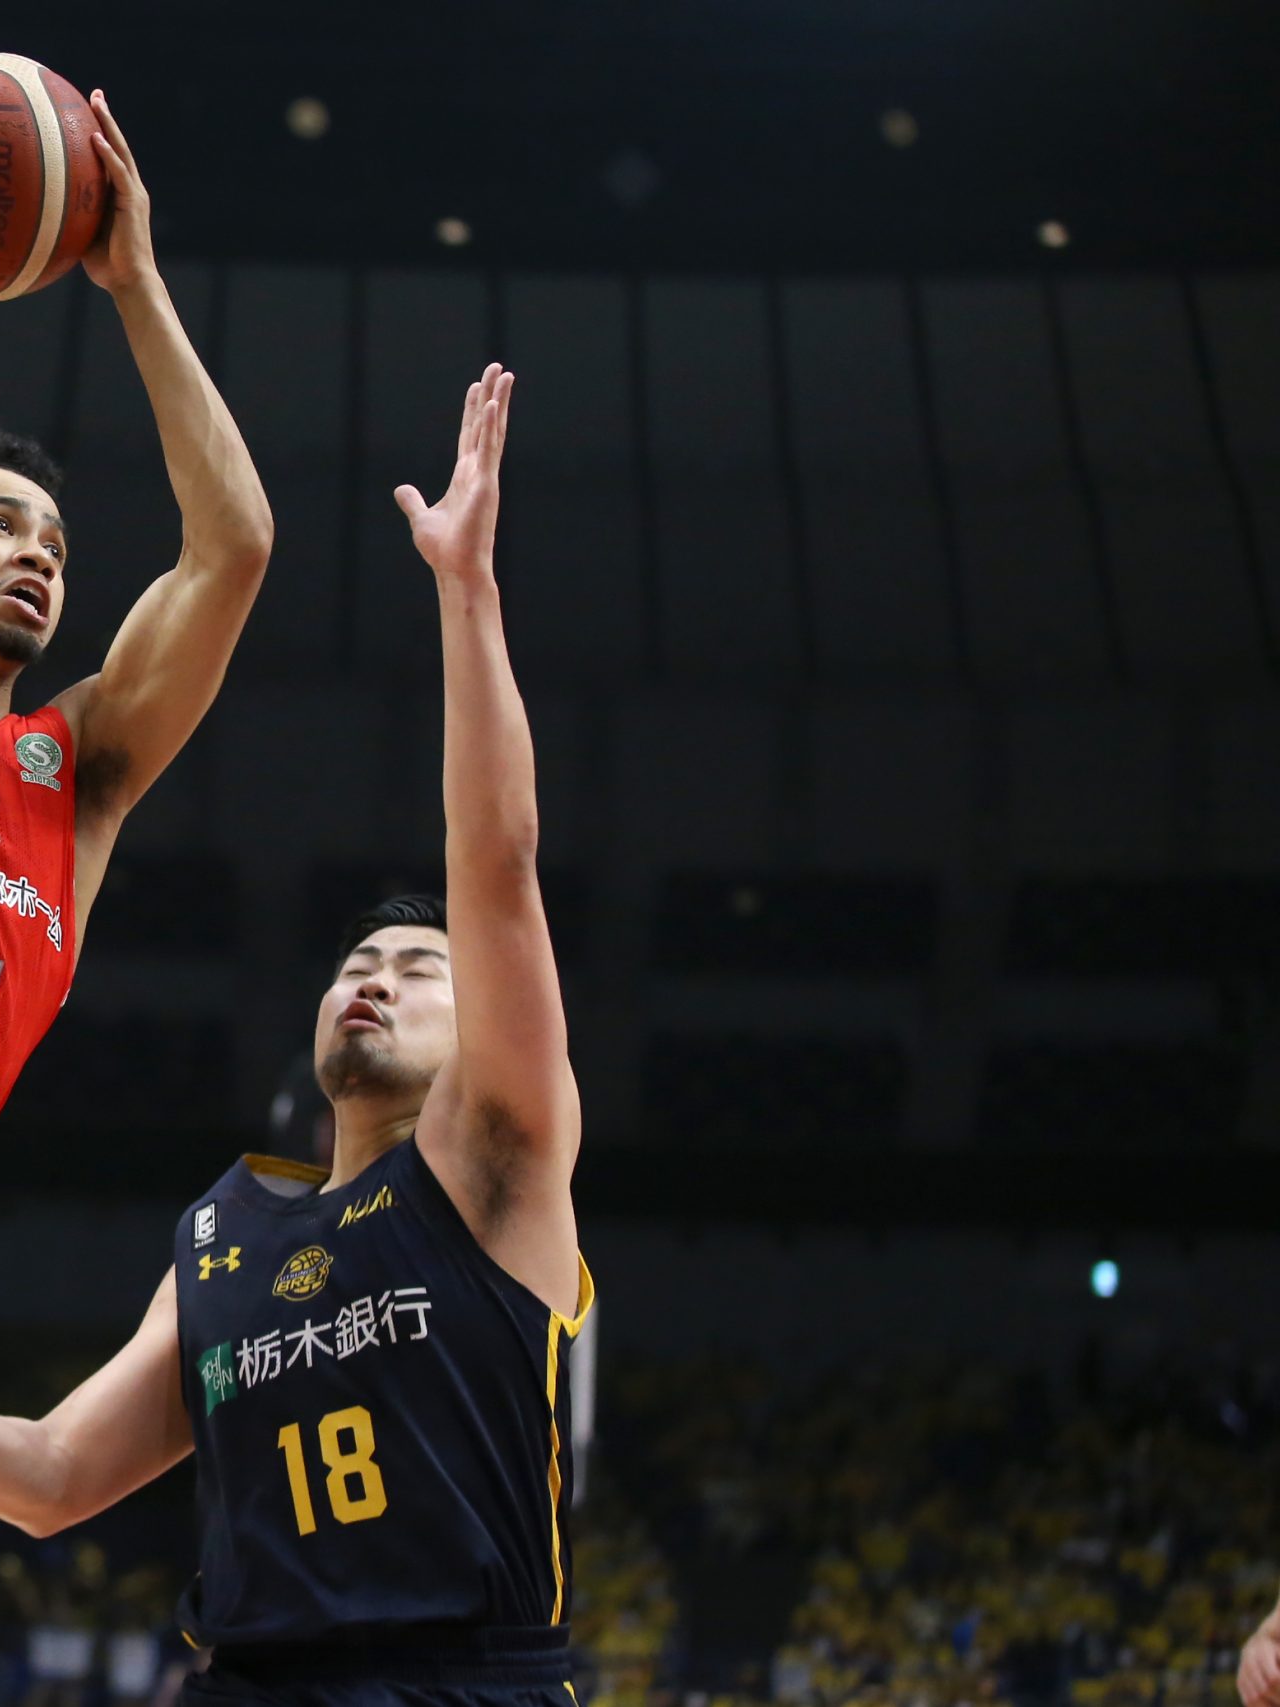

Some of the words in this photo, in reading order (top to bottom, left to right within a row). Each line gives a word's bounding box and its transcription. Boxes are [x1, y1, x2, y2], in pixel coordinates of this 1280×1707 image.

[236, 1286, 433, 1389] 栃木銀行
[277, 1404, 388, 1537] 18
